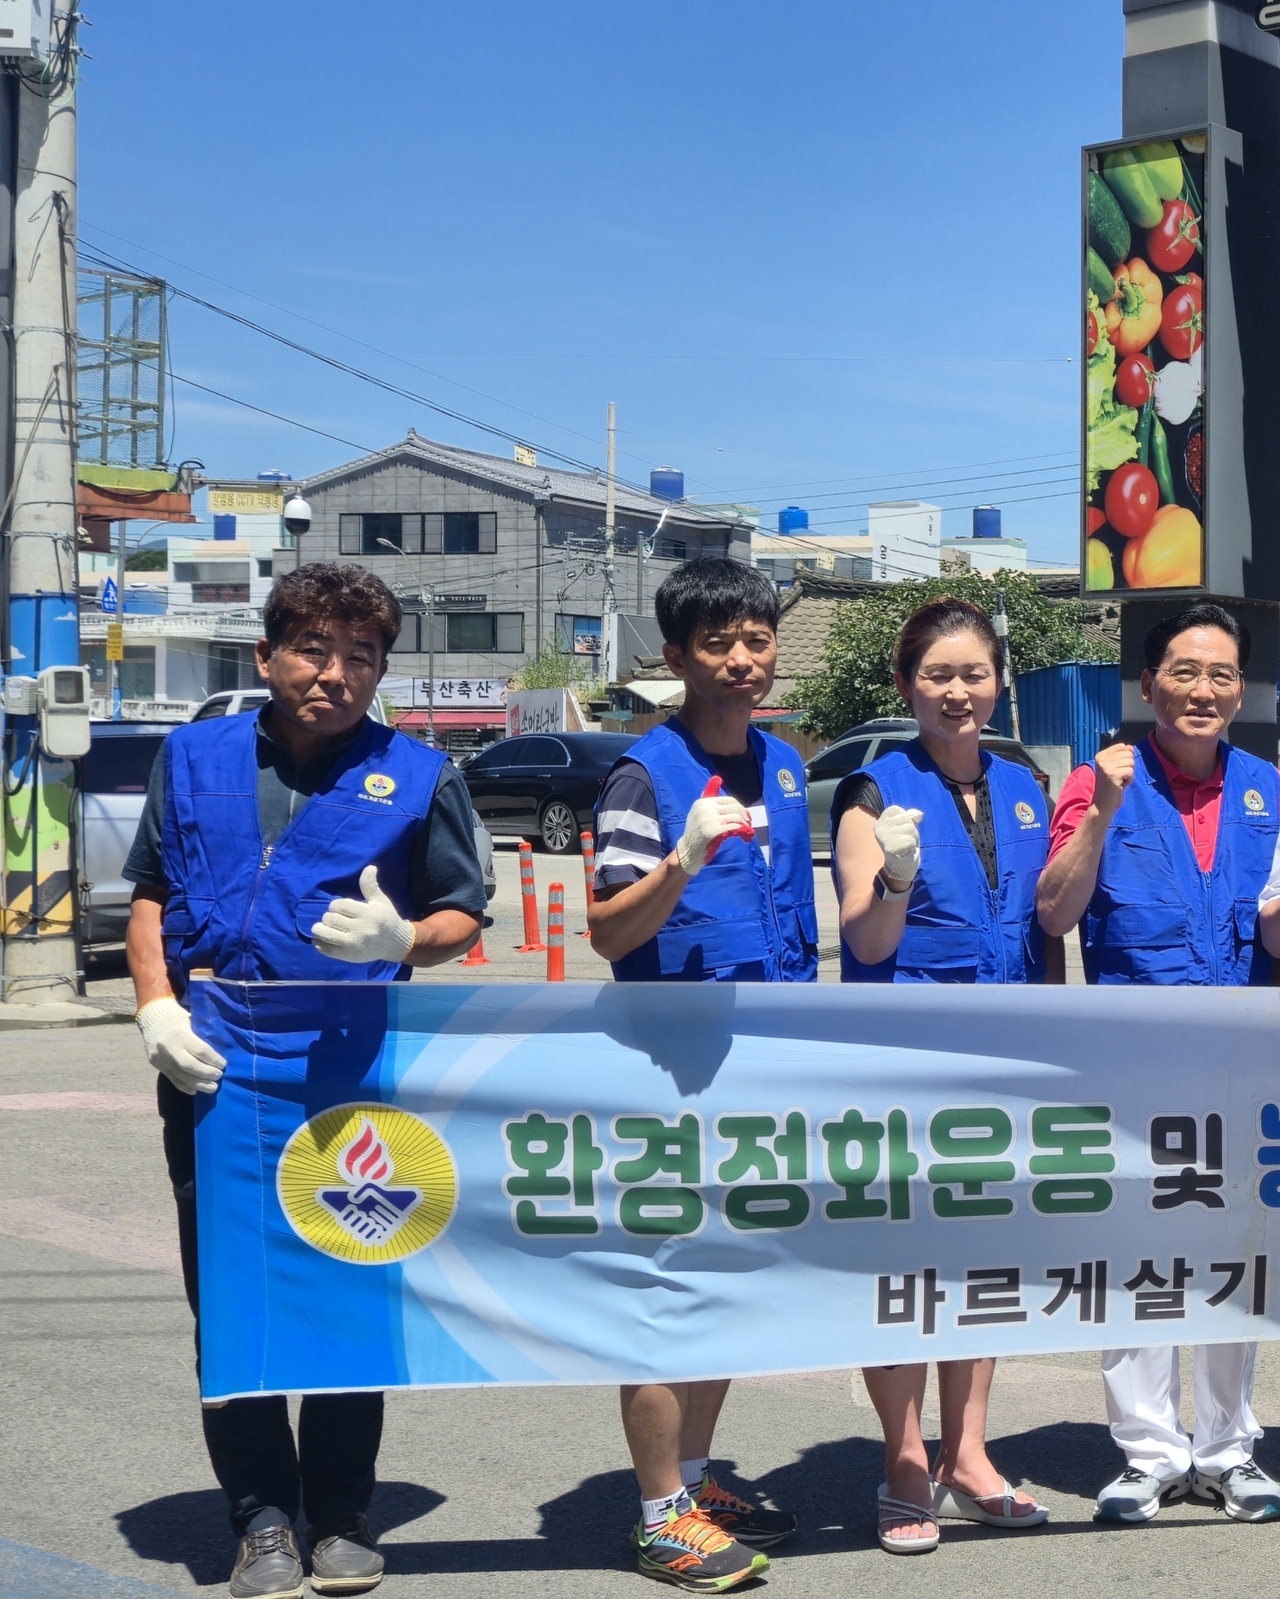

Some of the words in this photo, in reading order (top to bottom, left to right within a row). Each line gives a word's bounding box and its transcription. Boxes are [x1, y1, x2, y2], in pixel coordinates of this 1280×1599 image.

[236, 493, 255, 507] CCTV
[420, 680, 492, 699] 부산축산
[504, 1105, 1116, 1235] 환경정화운동
[1150, 1112, 1226, 1210] 및
